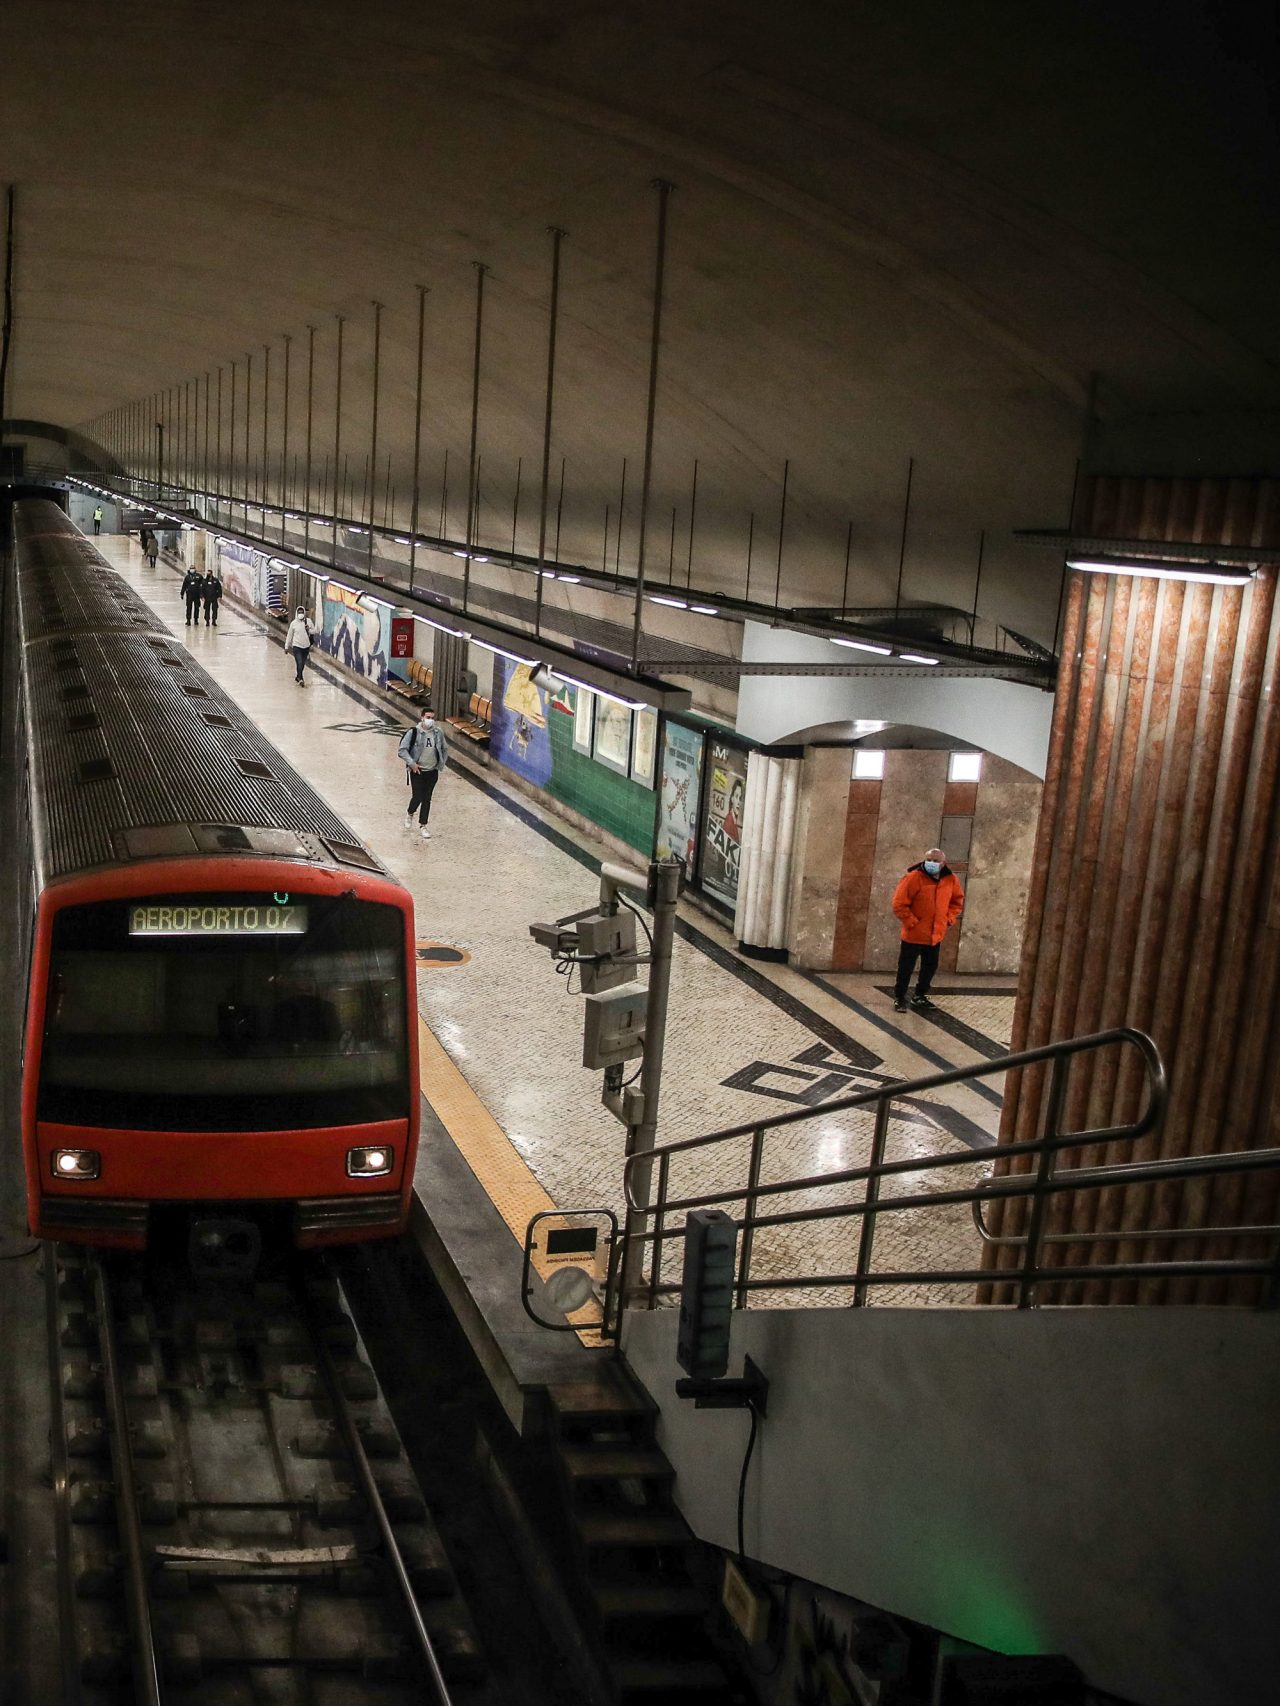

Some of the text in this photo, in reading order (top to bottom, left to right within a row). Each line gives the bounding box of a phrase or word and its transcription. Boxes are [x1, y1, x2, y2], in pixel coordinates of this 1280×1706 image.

[425, 737, 433, 748] A
[712, 793, 725, 811] 160
[706, 816, 741, 868] FAK
[132, 906, 294, 931] AEROPORTO 07
